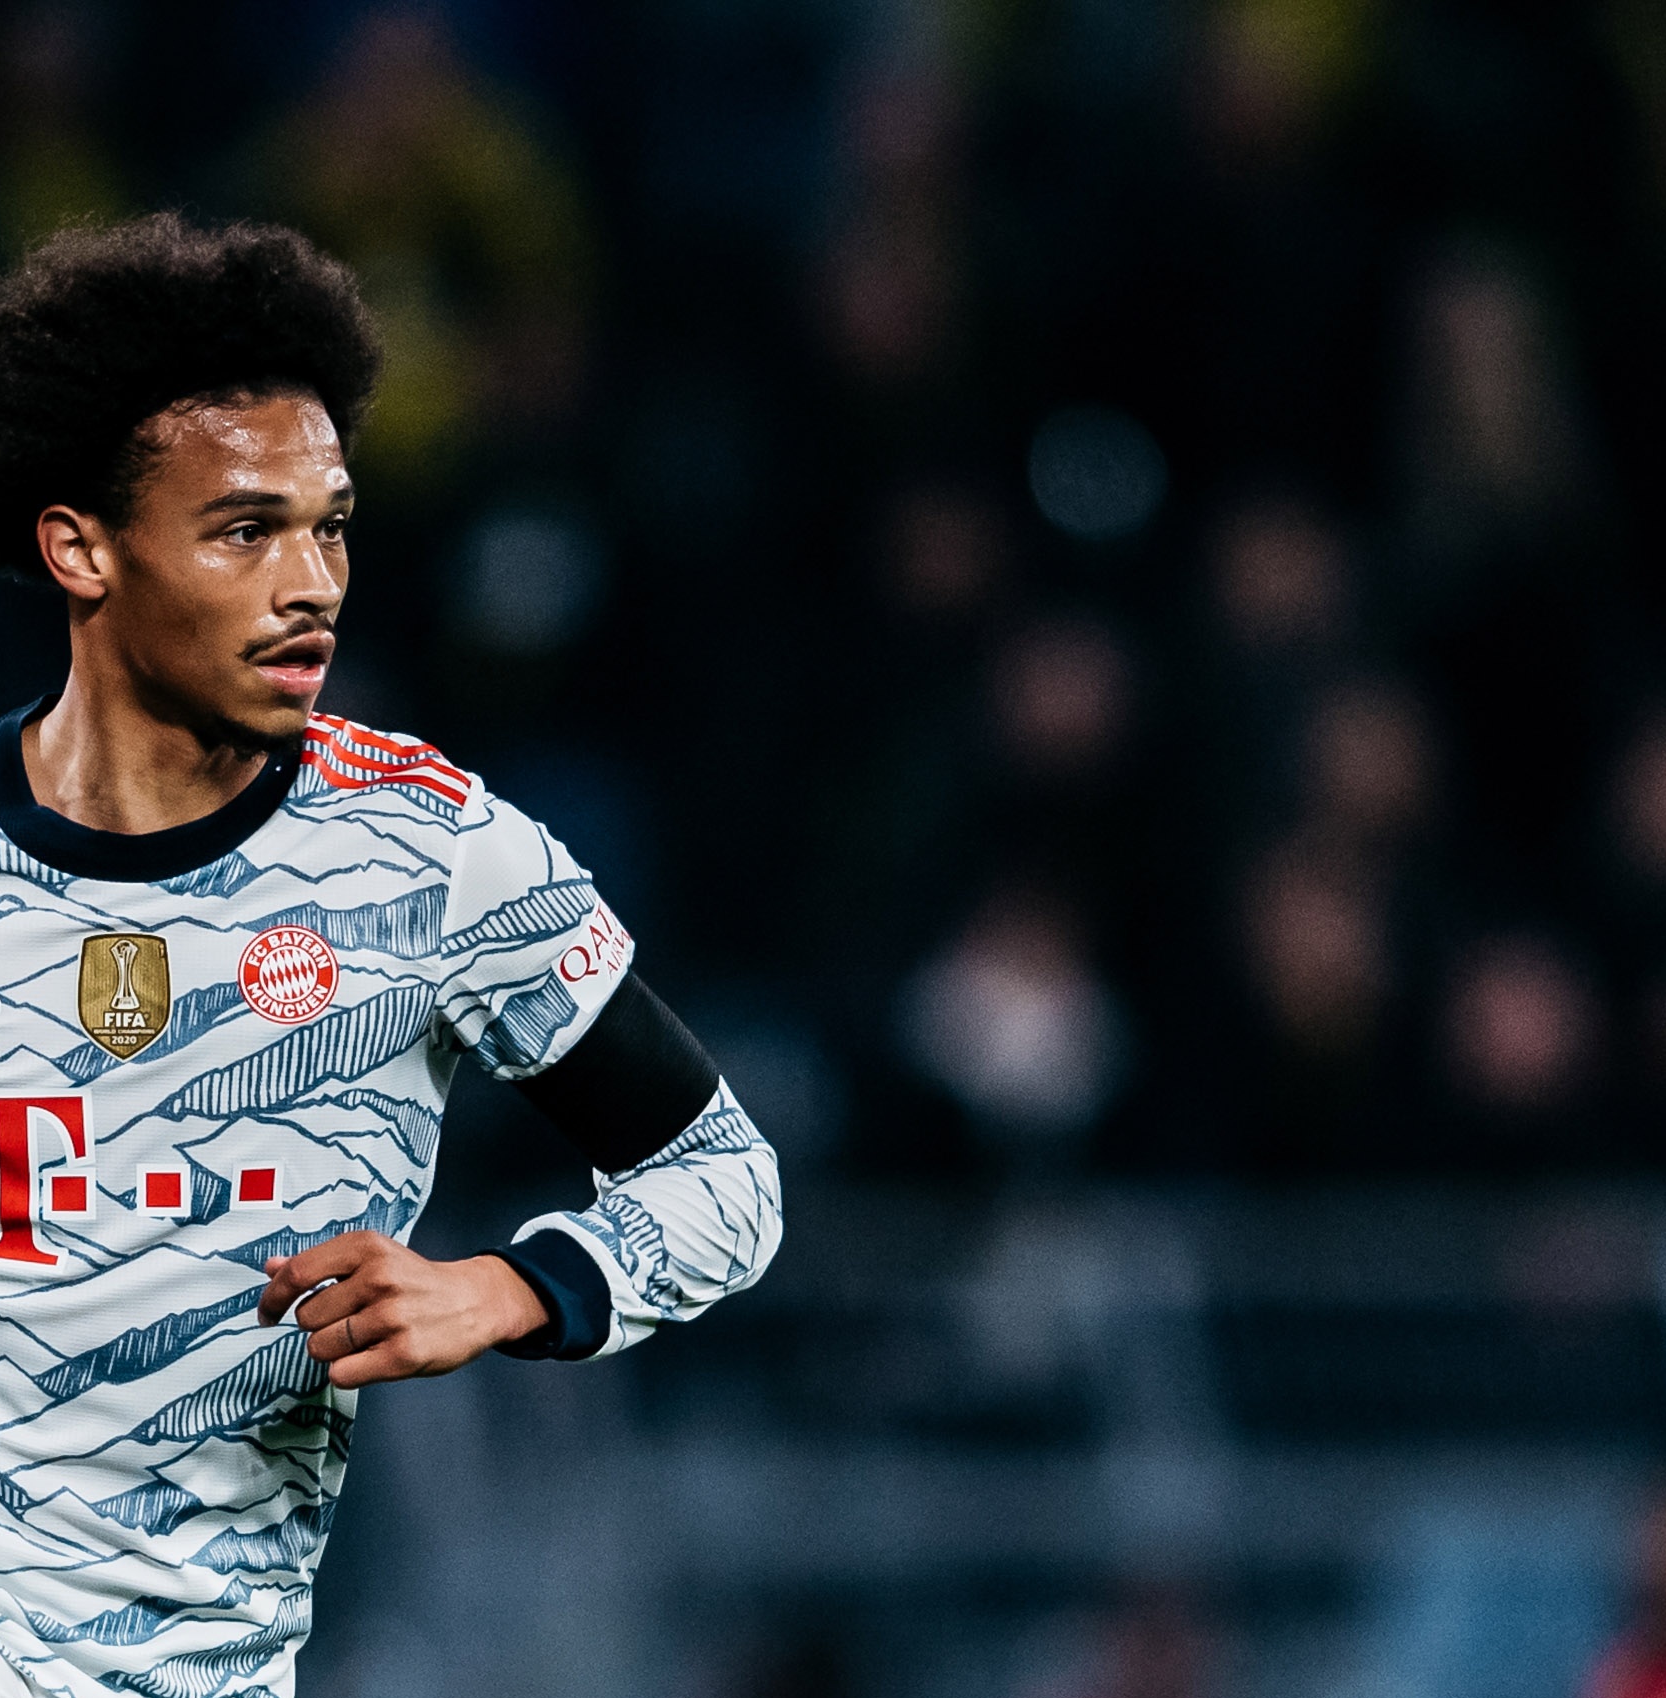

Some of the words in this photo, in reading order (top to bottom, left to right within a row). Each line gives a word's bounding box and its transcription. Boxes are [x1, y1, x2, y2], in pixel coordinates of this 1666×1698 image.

[247, 944, 267, 967] FC
[267, 931, 330, 969] BAYERN
[560, 904, 617, 982] QAT
[104, 1012, 146, 1027] FIFA
[111, 1035, 137, 1044] 2020
